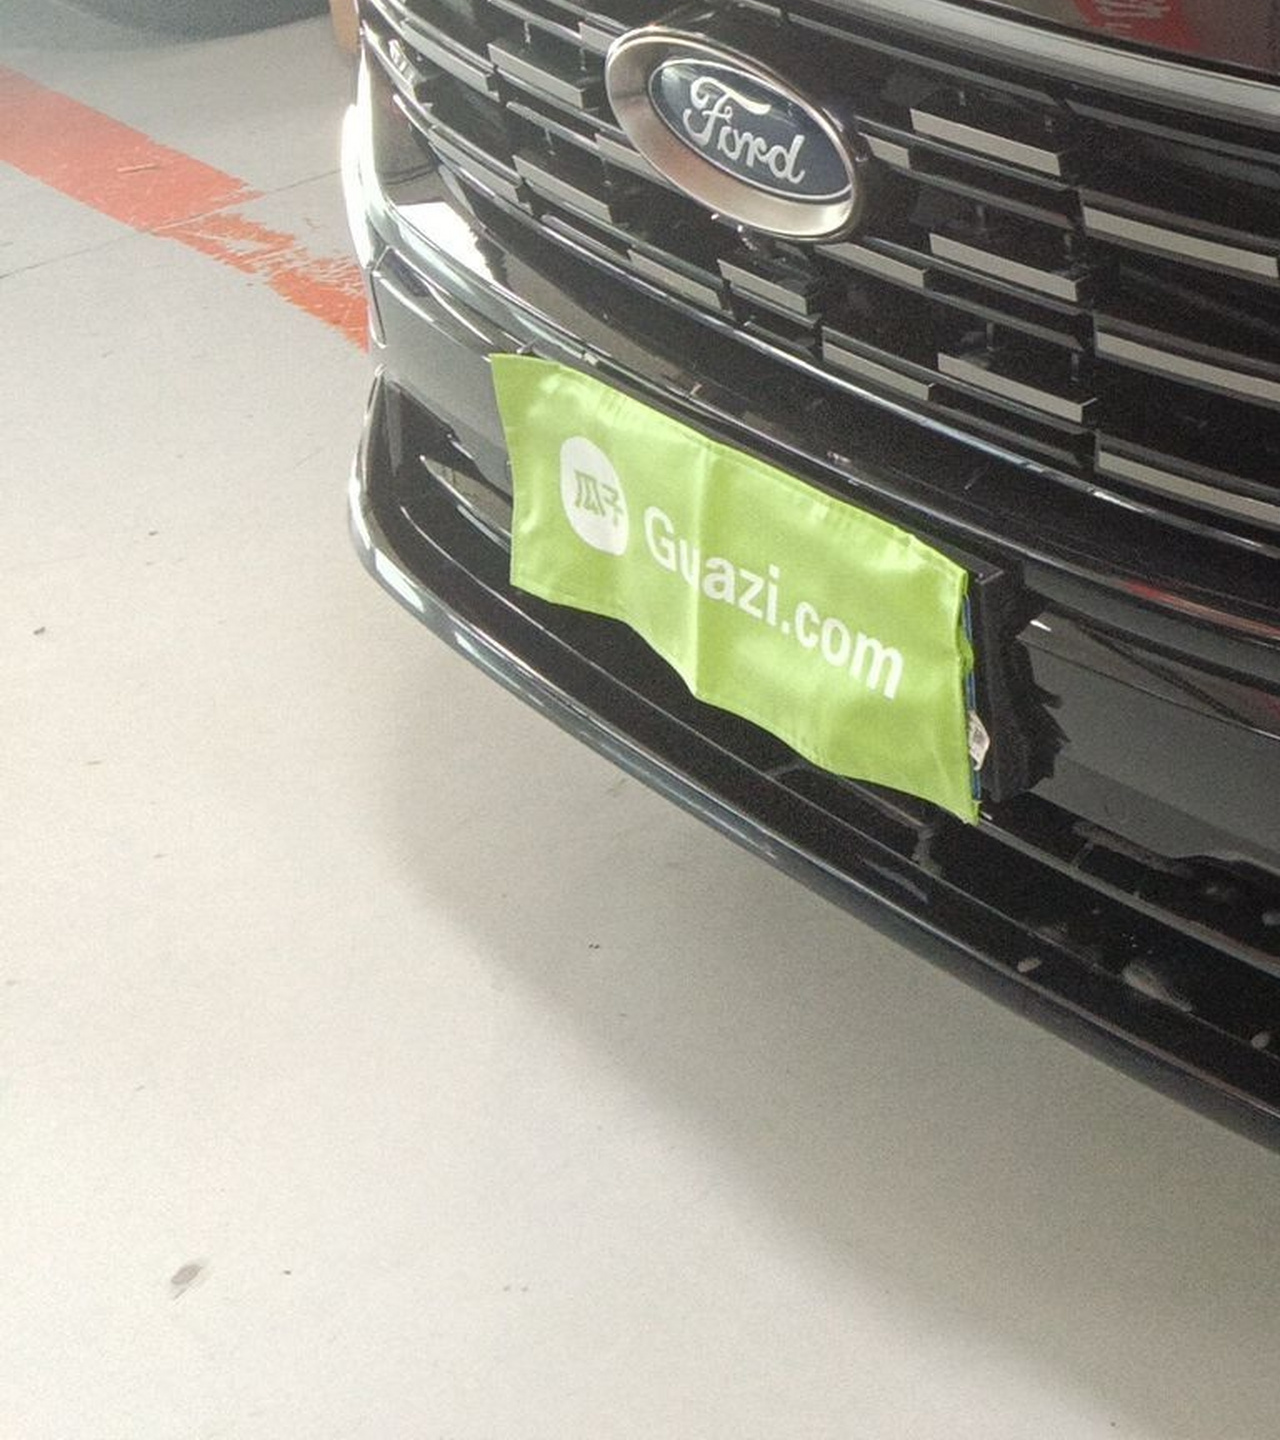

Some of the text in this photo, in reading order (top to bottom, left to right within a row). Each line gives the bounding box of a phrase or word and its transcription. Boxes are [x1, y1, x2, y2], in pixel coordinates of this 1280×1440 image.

[682, 75, 806, 185] Ford
[573, 467, 624, 528] 瓜子
[643, 505, 905, 701] Guazi.com
